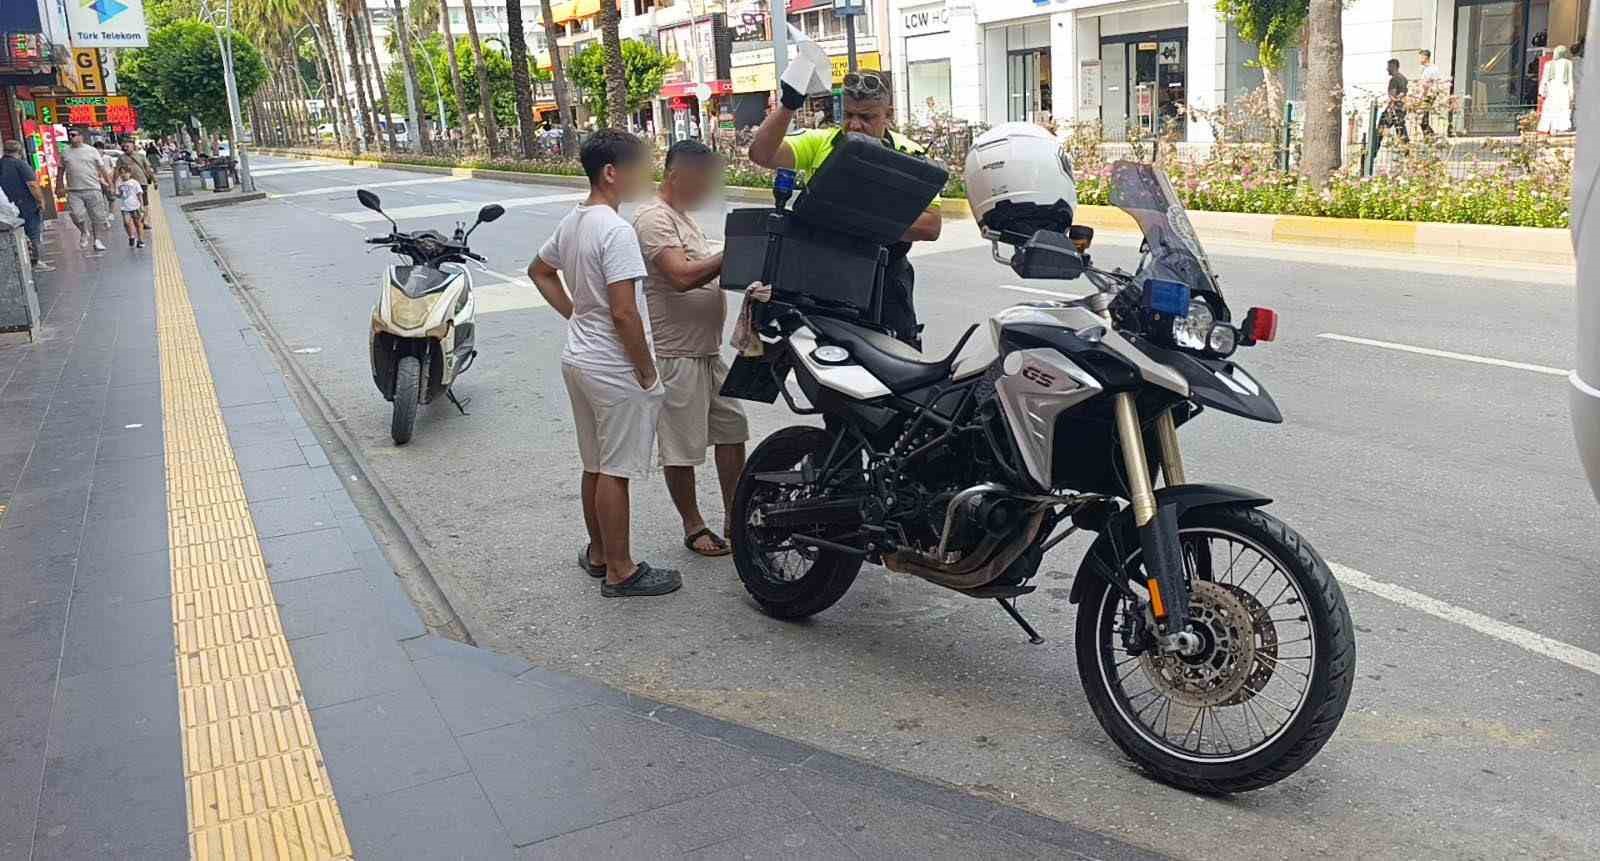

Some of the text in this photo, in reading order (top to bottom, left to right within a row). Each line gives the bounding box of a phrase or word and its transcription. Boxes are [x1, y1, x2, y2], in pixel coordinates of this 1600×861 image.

[905, 12, 929, 29] LCW
[102, 31, 142, 39] Telekom
[1023, 366, 1055, 387] GS
